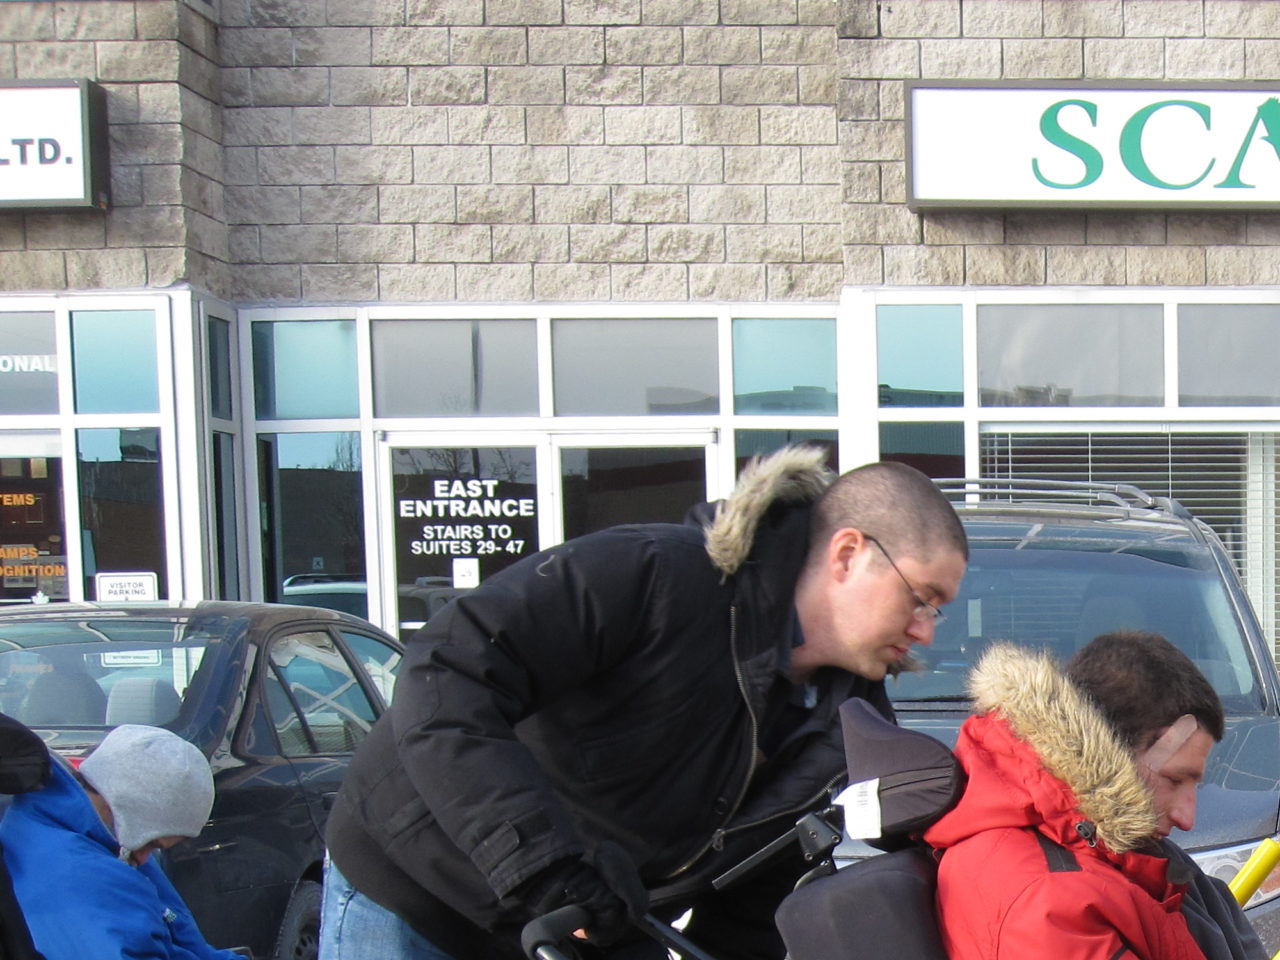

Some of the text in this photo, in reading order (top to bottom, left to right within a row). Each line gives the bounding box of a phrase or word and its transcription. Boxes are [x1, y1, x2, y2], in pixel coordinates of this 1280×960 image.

[434, 480, 498, 498] EAST
[0, 493, 35, 506] EMS
[400, 499, 535, 518] ENTRANCE
[423, 524, 512, 540] STAIRS TO
[411, 541, 472, 555] SUITES
[505, 540, 525, 554] 47
